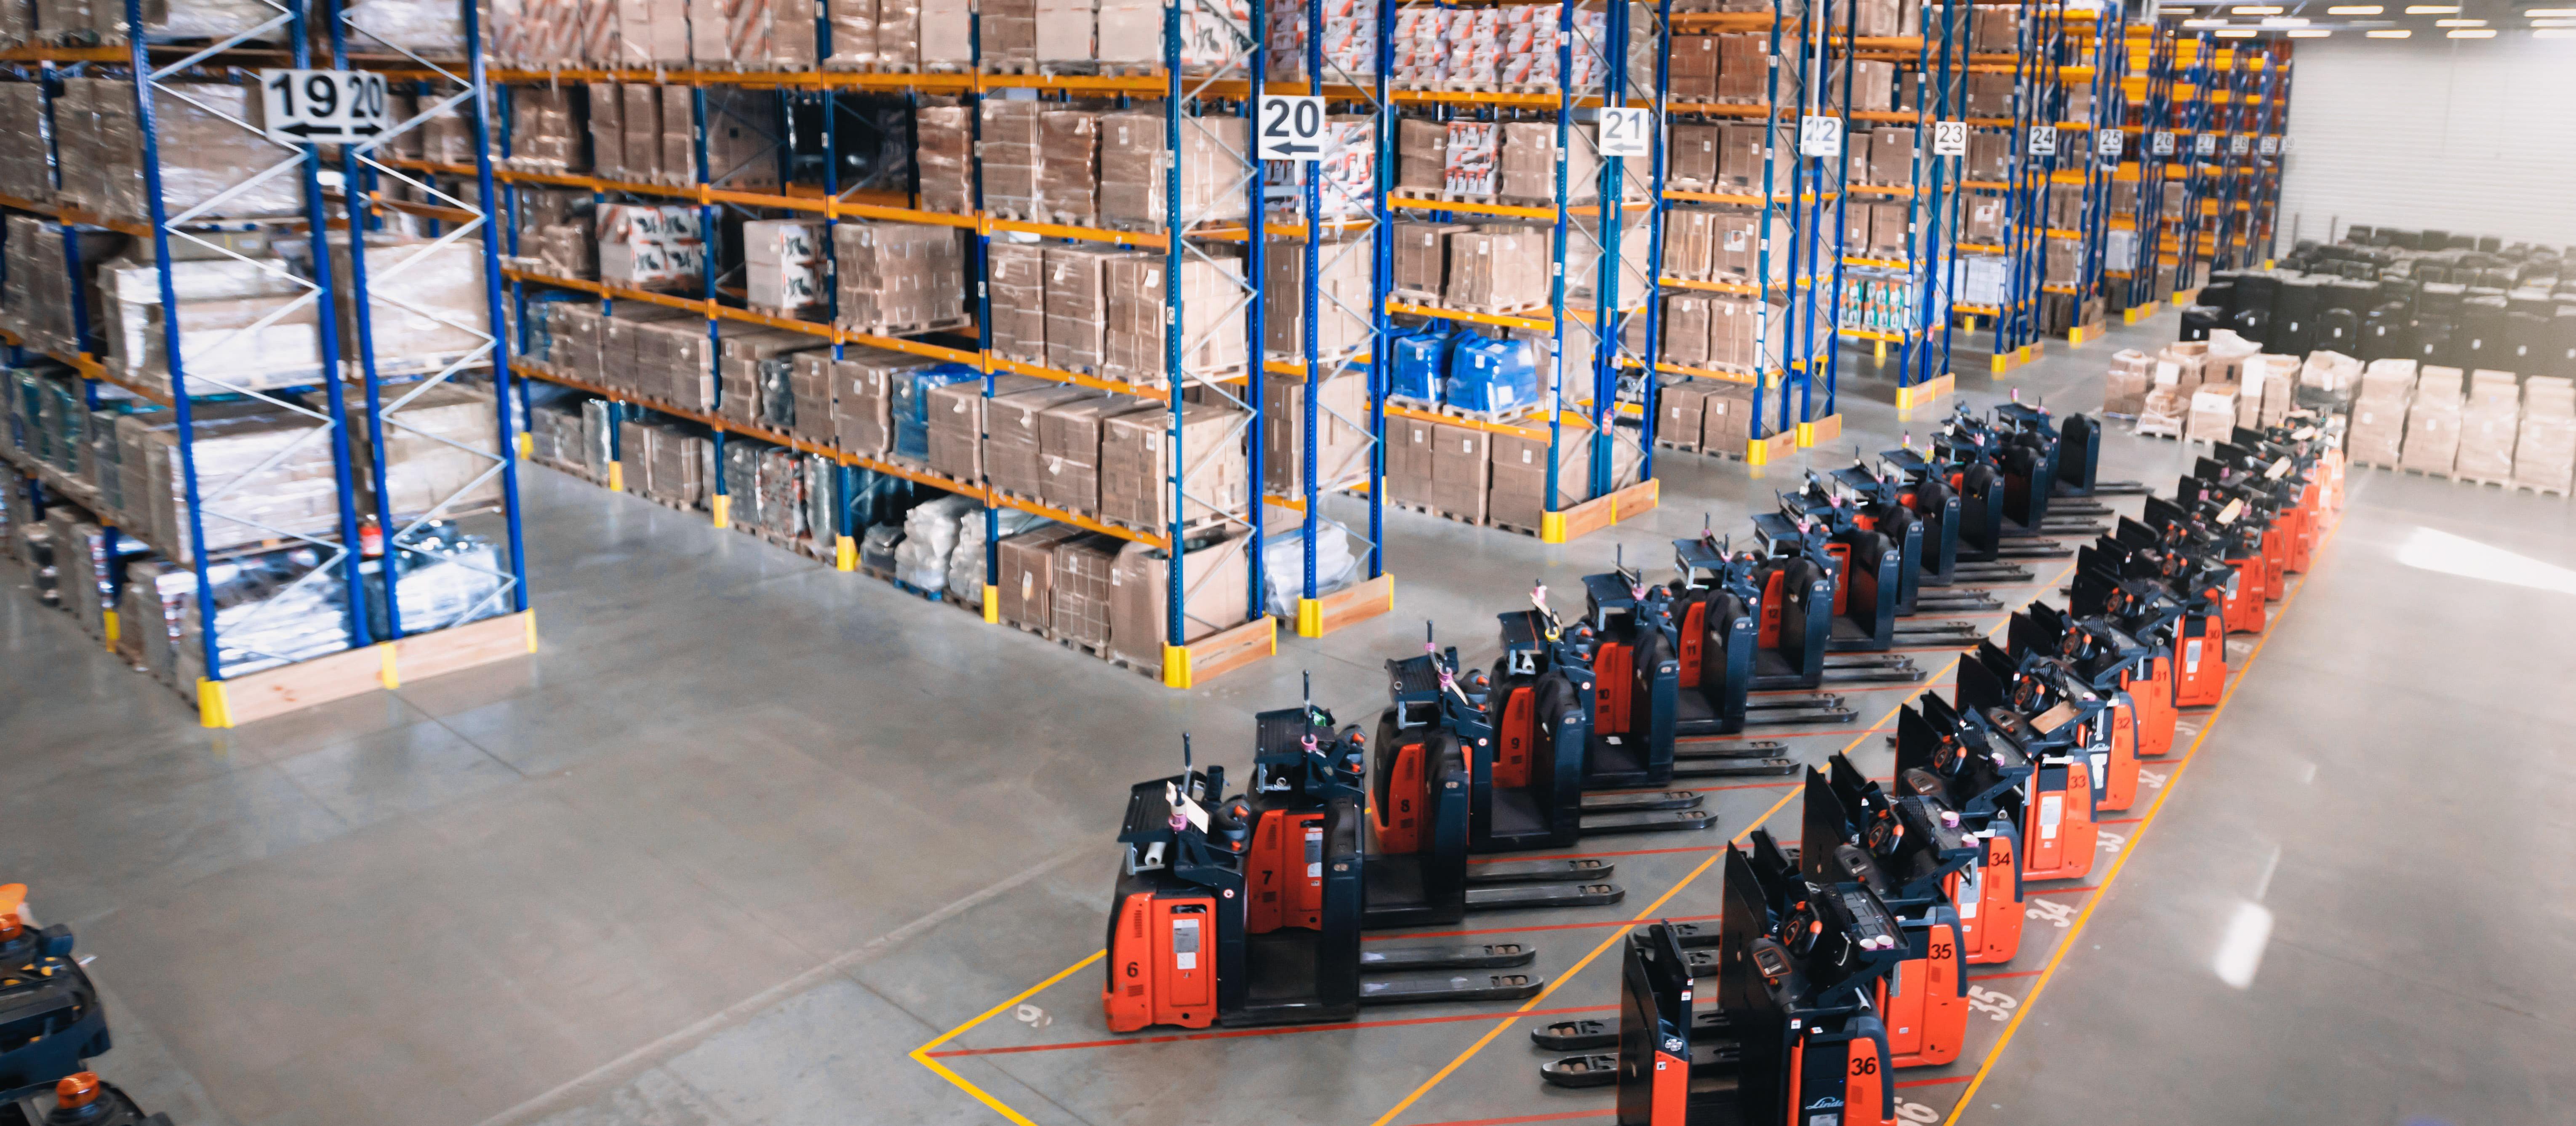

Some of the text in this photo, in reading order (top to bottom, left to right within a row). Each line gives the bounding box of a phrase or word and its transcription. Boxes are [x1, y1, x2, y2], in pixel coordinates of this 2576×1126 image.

[270, 72, 337, 117] 19
[348, 75, 384, 117] 20
[1264, 98, 1320, 138] 20
[1605, 111, 1640, 139] 21
[1805, 119, 1836, 142] 22
[1939, 125, 1963, 143] 23
[2033, 128, 2053, 144] 24
[2103, 131, 2120, 145] 25
[2156, 133, 2173, 146] 26
[2200, 134, 2214, 146] 27
[1168, 154, 1173, 165] H
[1167, 310, 1174, 320] G
[1168, 415, 1174, 426] F
[1768, 609, 1779, 619] 12
[2208, 630, 2220, 639] 30
[1686, 645, 1696, 655] 11
[2154, 671, 2167, 682] 31
[1598, 688, 1610, 700] 10
[2115, 717, 2131, 729] 32
[1511, 737, 1519, 749] 9
[2069, 775, 2086, 788] 33
[1400, 799, 1410, 813] 8
[1991, 852, 2011, 867] 34
[1262, 870, 1273, 884] 7
[2025, 898, 2078, 928] 34
[1930, 943, 1952, 960] 35
[1126, 961, 1139, 977] 6
[1968, 984, 2017, 1021] 35
[1851, 1056, 1876, 1076] 36
[1805, 1096, 1845, 1110] Linde
[1893, 1097, 1939, 1126] 6
